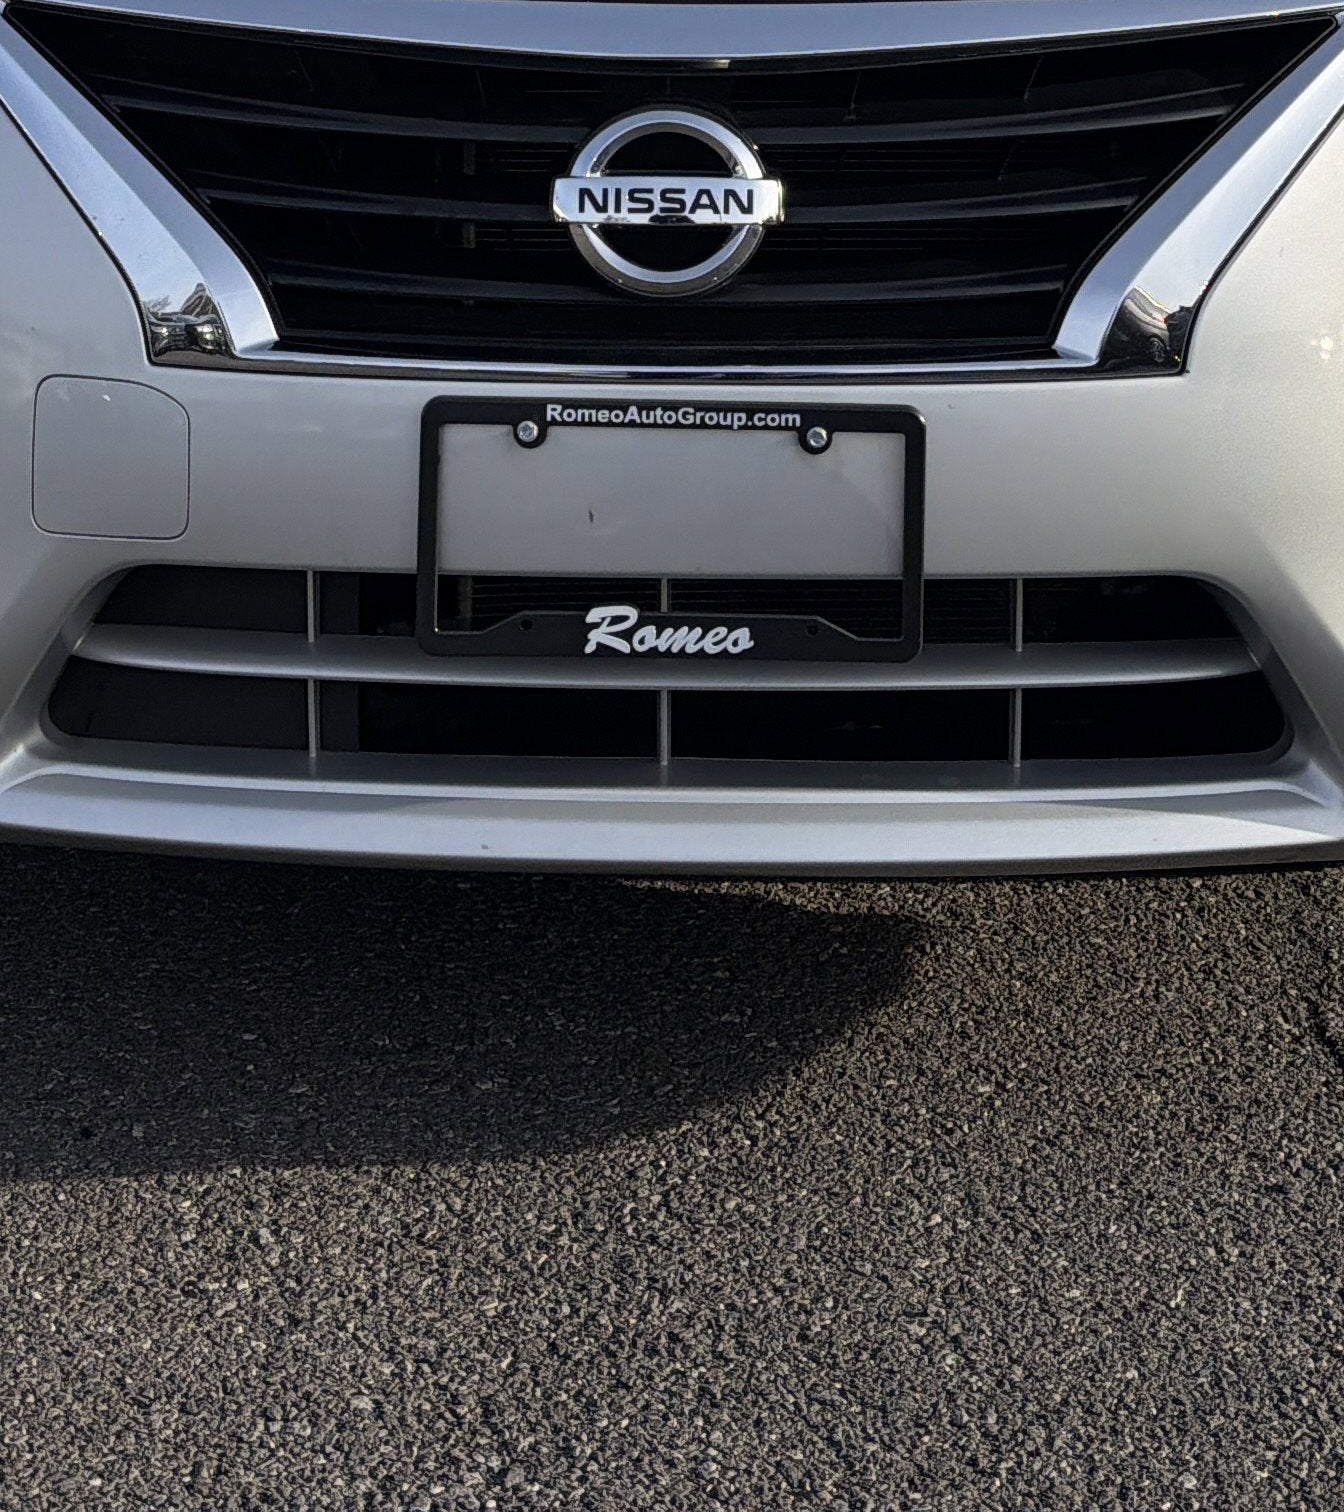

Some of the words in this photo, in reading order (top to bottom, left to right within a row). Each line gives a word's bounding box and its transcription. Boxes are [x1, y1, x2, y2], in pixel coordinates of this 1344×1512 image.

[578, 187, 754, 215] NISSAN
[545, 403, 801, 430] RomeoAutoGroup.com
[584, 605, 755, 654] Romeo
